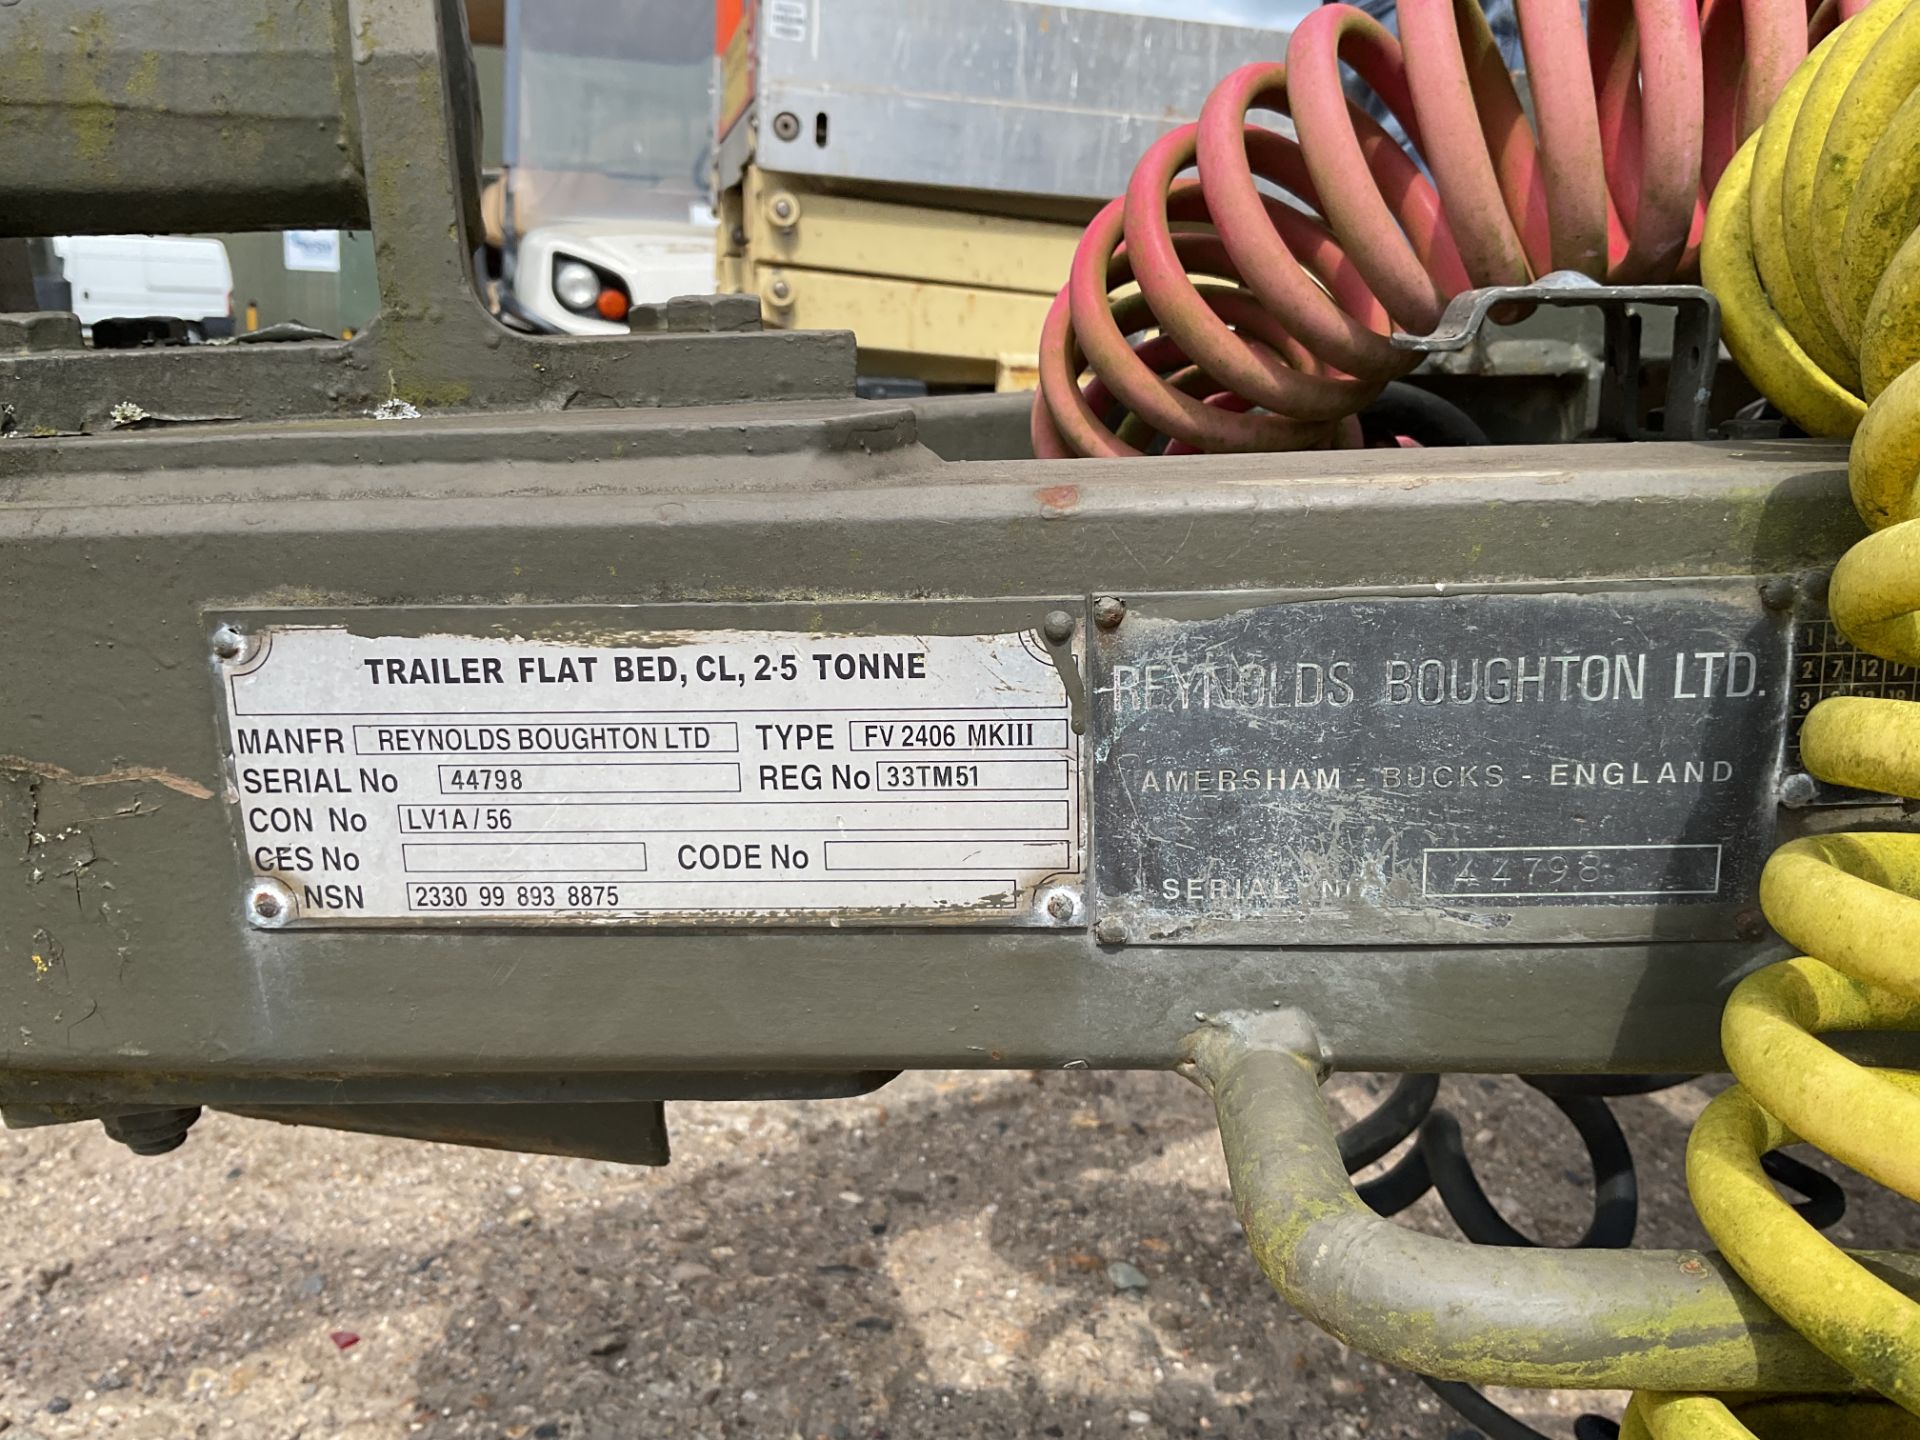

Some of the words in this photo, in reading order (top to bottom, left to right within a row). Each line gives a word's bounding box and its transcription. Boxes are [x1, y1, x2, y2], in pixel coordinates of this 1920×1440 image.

[1807, 628, 1814, 646] 1
[364, 658, 504, 684] TRAILER
[518, 657, 598, 683] FLAT
[812, 653, 926, 680] TONNE
[1113, 660, 1354, 711] REYNOLDS
[1385, 653, 1647, 707] BOUGHTON
[1674, 651, 1766, 700] LTD.
[1802, 661, 1813, 678] 2
[1832, 660, 1844, 677] 7
[1861, 659, 1879, 677] 12
[1800, 692, 1810, 709] 3
[238, 728, 345, 754] MANFR
[379, 728, 510, 751] REYNOLDS
[519, 727, 657, 750] BOUGHTON
[665, 726, 710, 749] LTD
[755, 724, 834, 750] TYPE
[865, 725, 894, 748] FV
[902, 724, 955, 747] 2406
[968, 723, 1033, 747] MKIII
[243, 768, 351, 793] SERIAL
[361, 768, 398, 793] No
[451, 769, 523, 790] 44798
[760, 764, 821, 790] REG
[833, 764, 870, 790] No
[887, 765, 979, 788] 33TM51
[1141, 767, 1341, 793] AMERSHAM
[1382, 766, 1504, 789] BUCKS
[1550, 761, 1734, 786] ENGLAND
[249, 807, 313, 833] CON
[330, 807, 367, 832] No
[254, 846, 314, 872] CES
[323, 846, 359, 872] No
[678, 844, 762, 869] CODE
[771, 844, 808, 869] No
[1455, 854, 1601, 887] 44798
[304, 884, 364, 909] NSN
[416, 887, 466, 907] 2330
[479, 887, 504, 907] 99
[517, 887, 555, 907] 893
[568, 886, 619, 907] 8875
[1162, 878, 1287, 900] SERIAL
